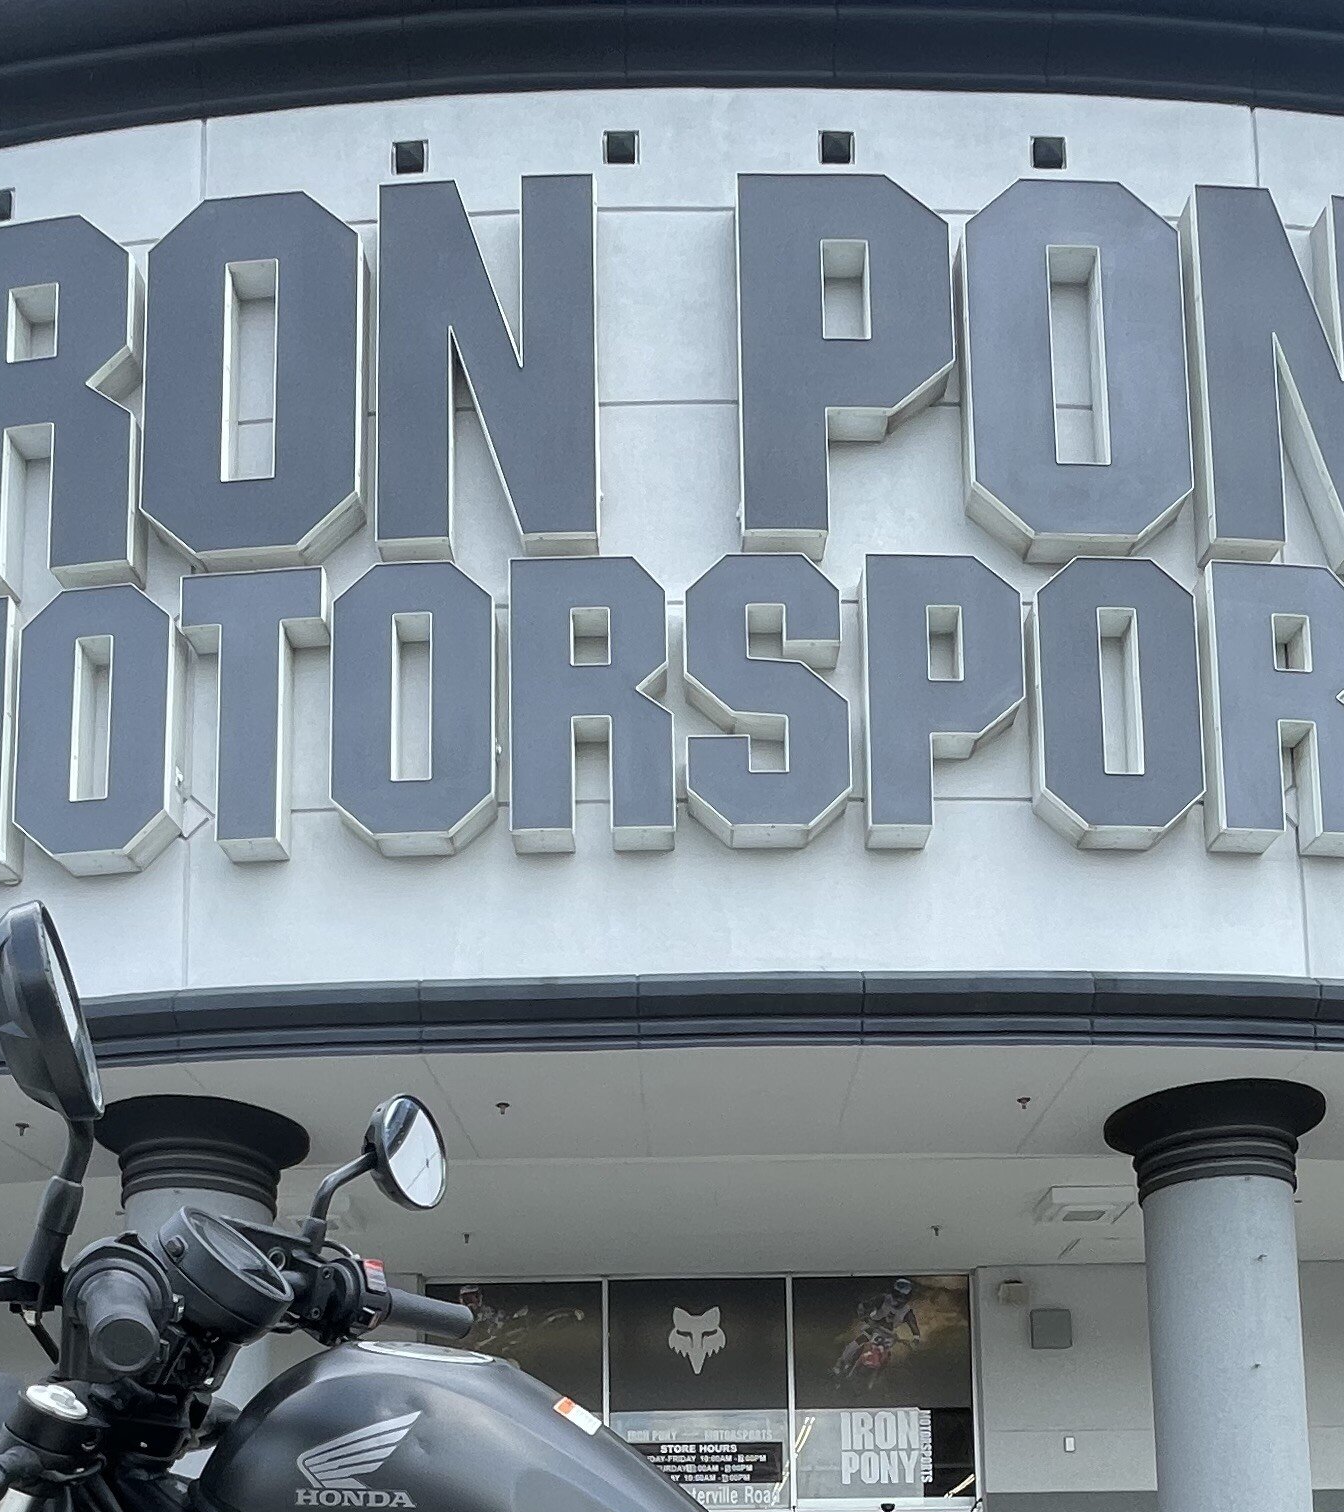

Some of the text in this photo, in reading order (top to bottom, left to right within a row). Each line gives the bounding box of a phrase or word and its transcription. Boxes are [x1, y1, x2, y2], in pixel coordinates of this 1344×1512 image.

[839, 1410, 921, 1451] IRON
[660, 1444, 738, 1454] STORE HOURS
[841, 1450, 921, 1485] PONY
[294, 1488, 417, 1509] HONDA
[744, 1485, 781, 1505] Road
